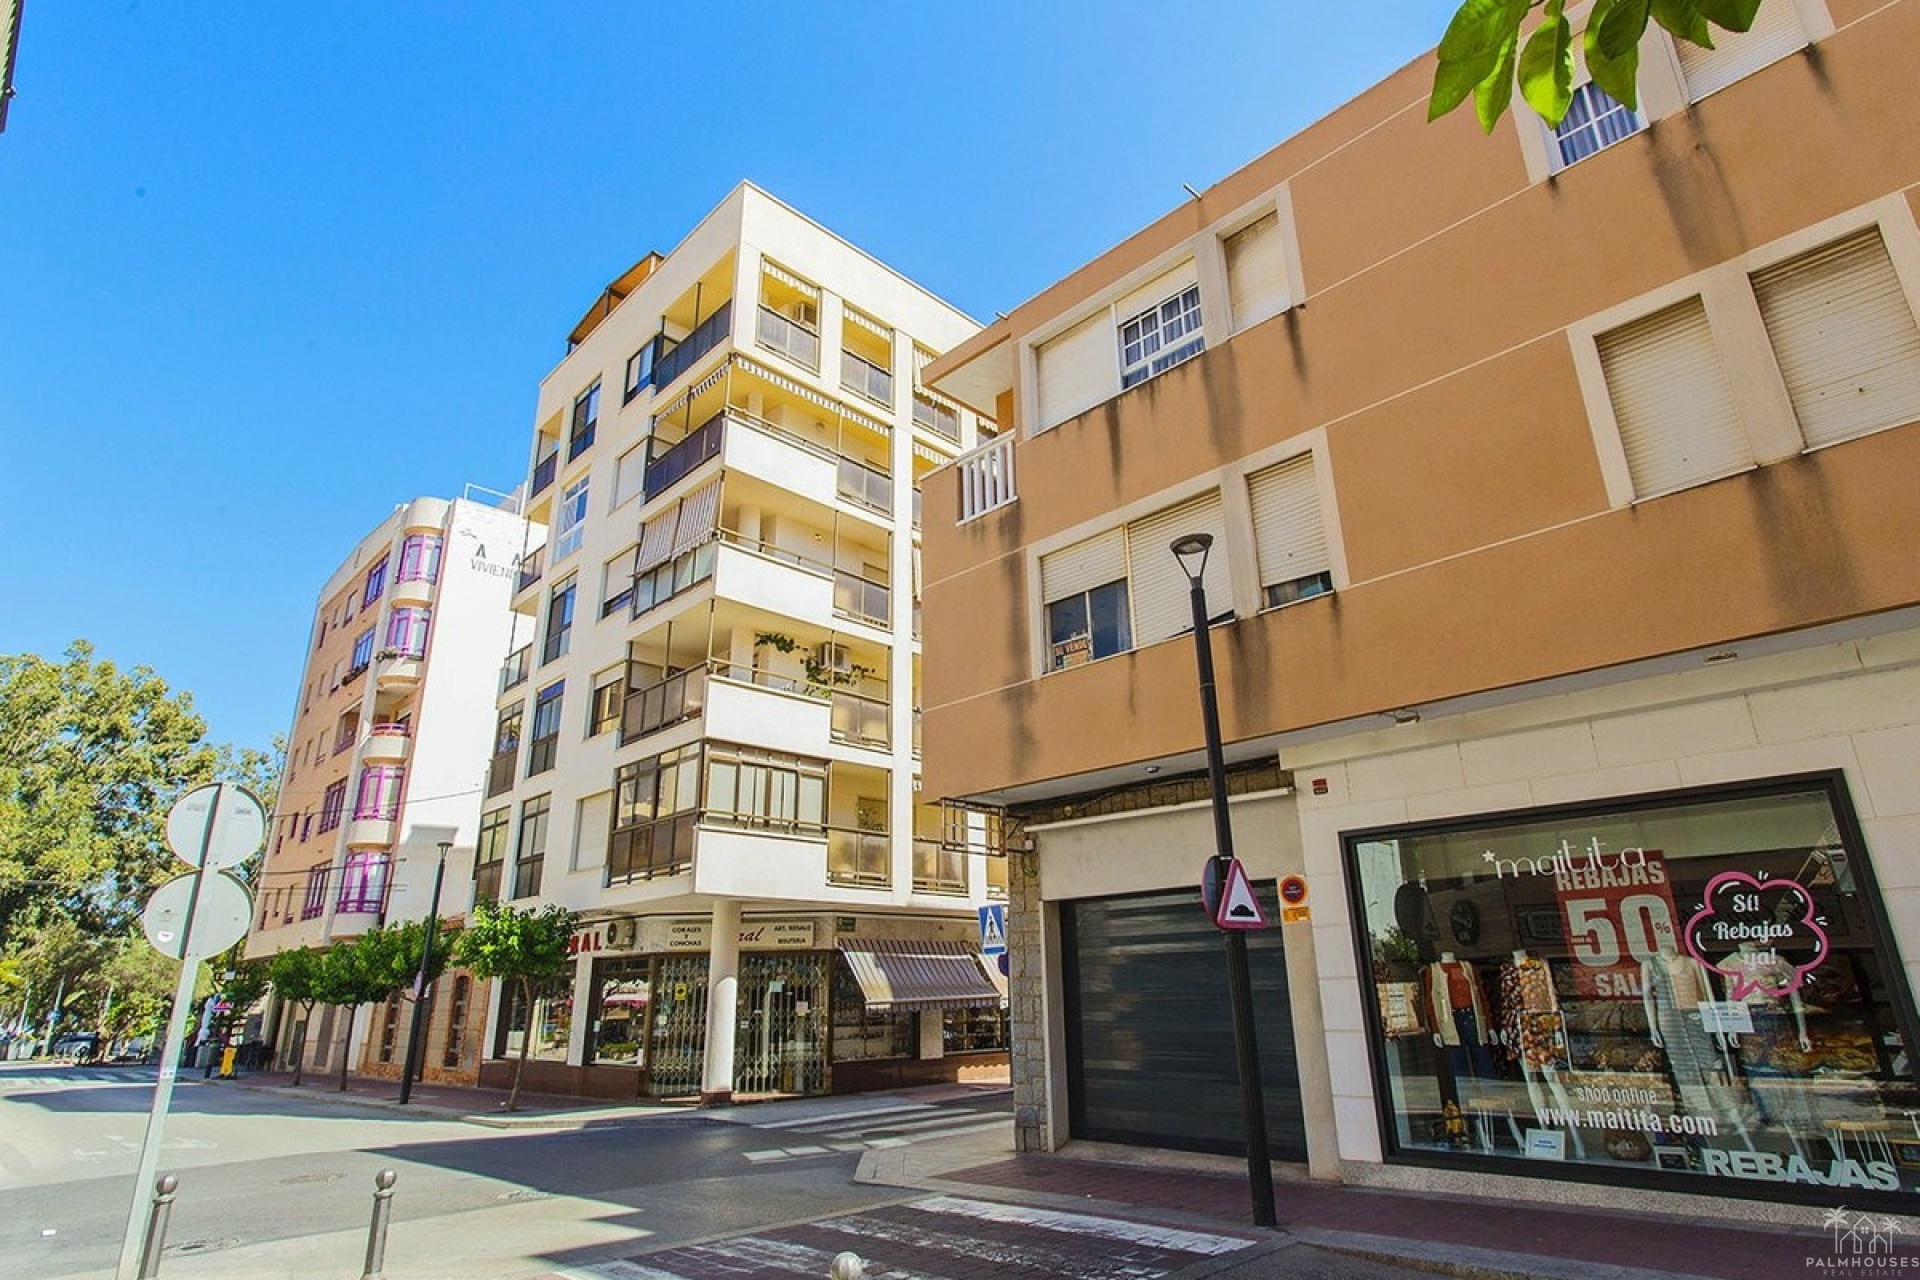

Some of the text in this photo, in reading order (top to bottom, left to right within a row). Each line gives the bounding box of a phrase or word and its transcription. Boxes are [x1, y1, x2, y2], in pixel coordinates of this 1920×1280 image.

[1555, 860, 1665, 892] REBAJAS
[568, 931, 602, 955] RAL
[738, 927, 765, 942] ral
[1713, 921, 1793, 942] Rebajas
[1743, 947, 1777, 970] ya!
[1594, 970, 1650, 997] SAL
[1577, 1085, 1657, 1105] shop online
[1536, 1107, 1718, 1137] www.maitita.com
[1700, 1148, 1900, 1191] REBAJAS
